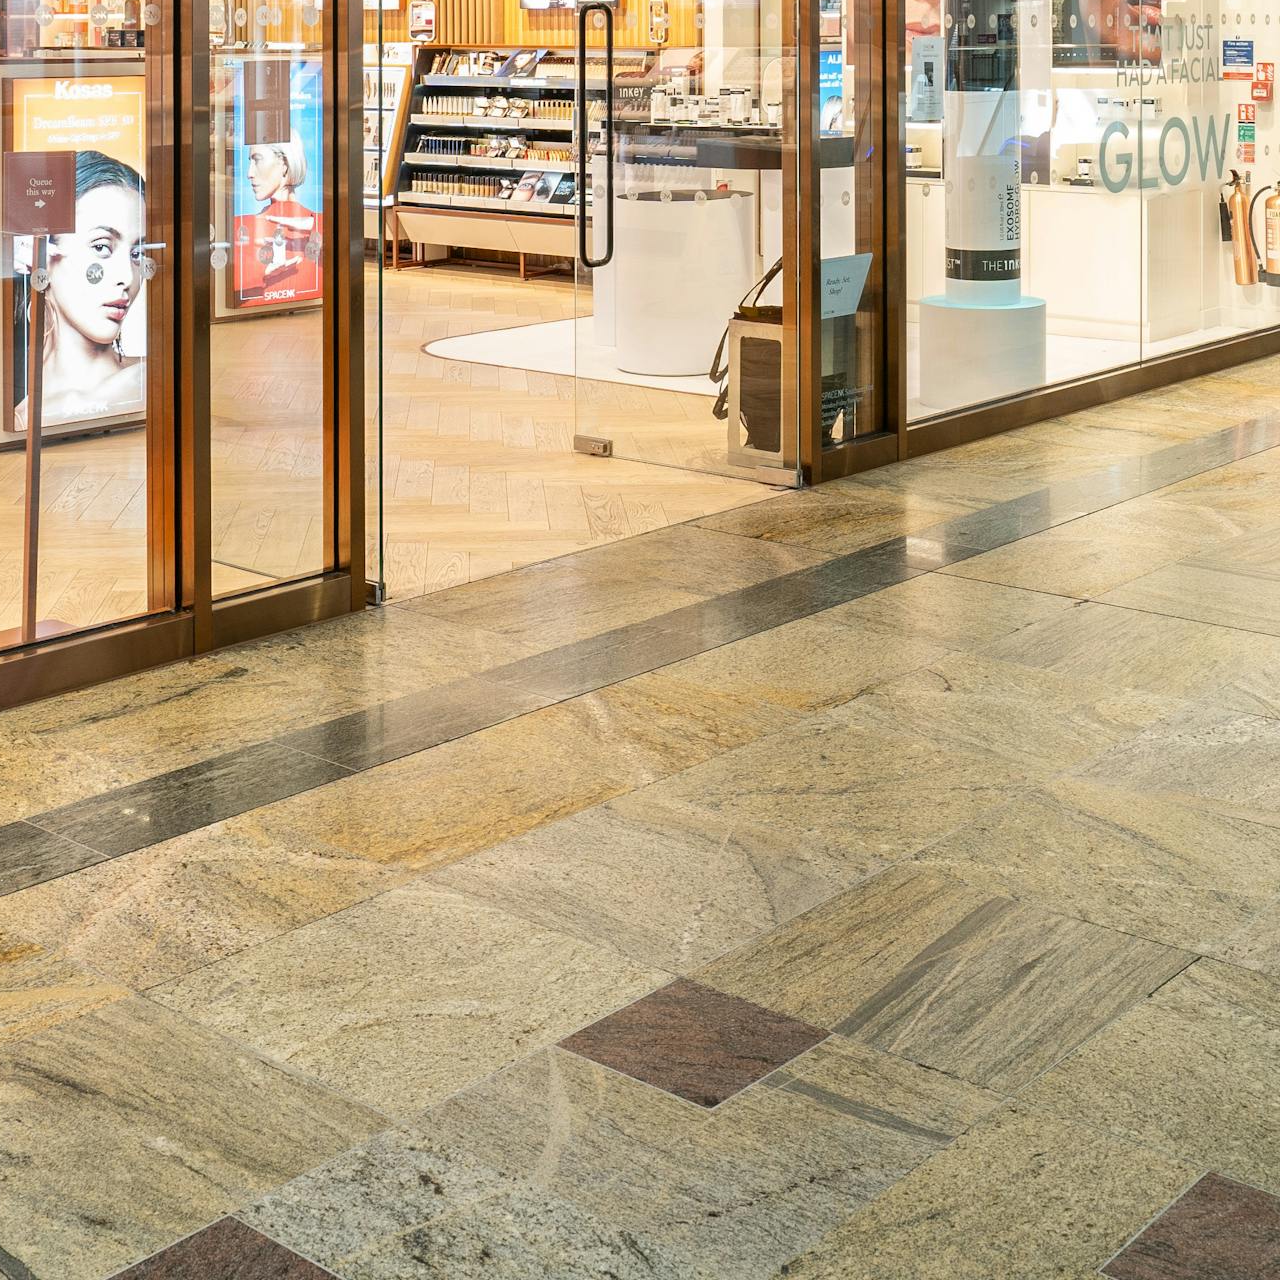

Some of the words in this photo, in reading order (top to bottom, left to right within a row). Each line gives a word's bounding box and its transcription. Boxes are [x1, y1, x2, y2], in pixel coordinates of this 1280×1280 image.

[1128, 25, 1173, 52] THAT
[1176, 24, 1213, 50] JUST
[1116, 58, 1152, 87] HAD
[1156, 58, 1167, 84] A
[1171, 55, 1224, 84] FACIAL
[54, 80, 113, 99] Kosas
[1099, 113, 1231, 193] GLOW
[29, 177, 53, 186] Queue
[26, 187, 40, 196] this
[41, 189, 56, 197] way
[1006, 184, 1015, 240] EXOSOME
[982, 260, 1003, 271] THE
[264, 289, 295, 300] SPACENK
